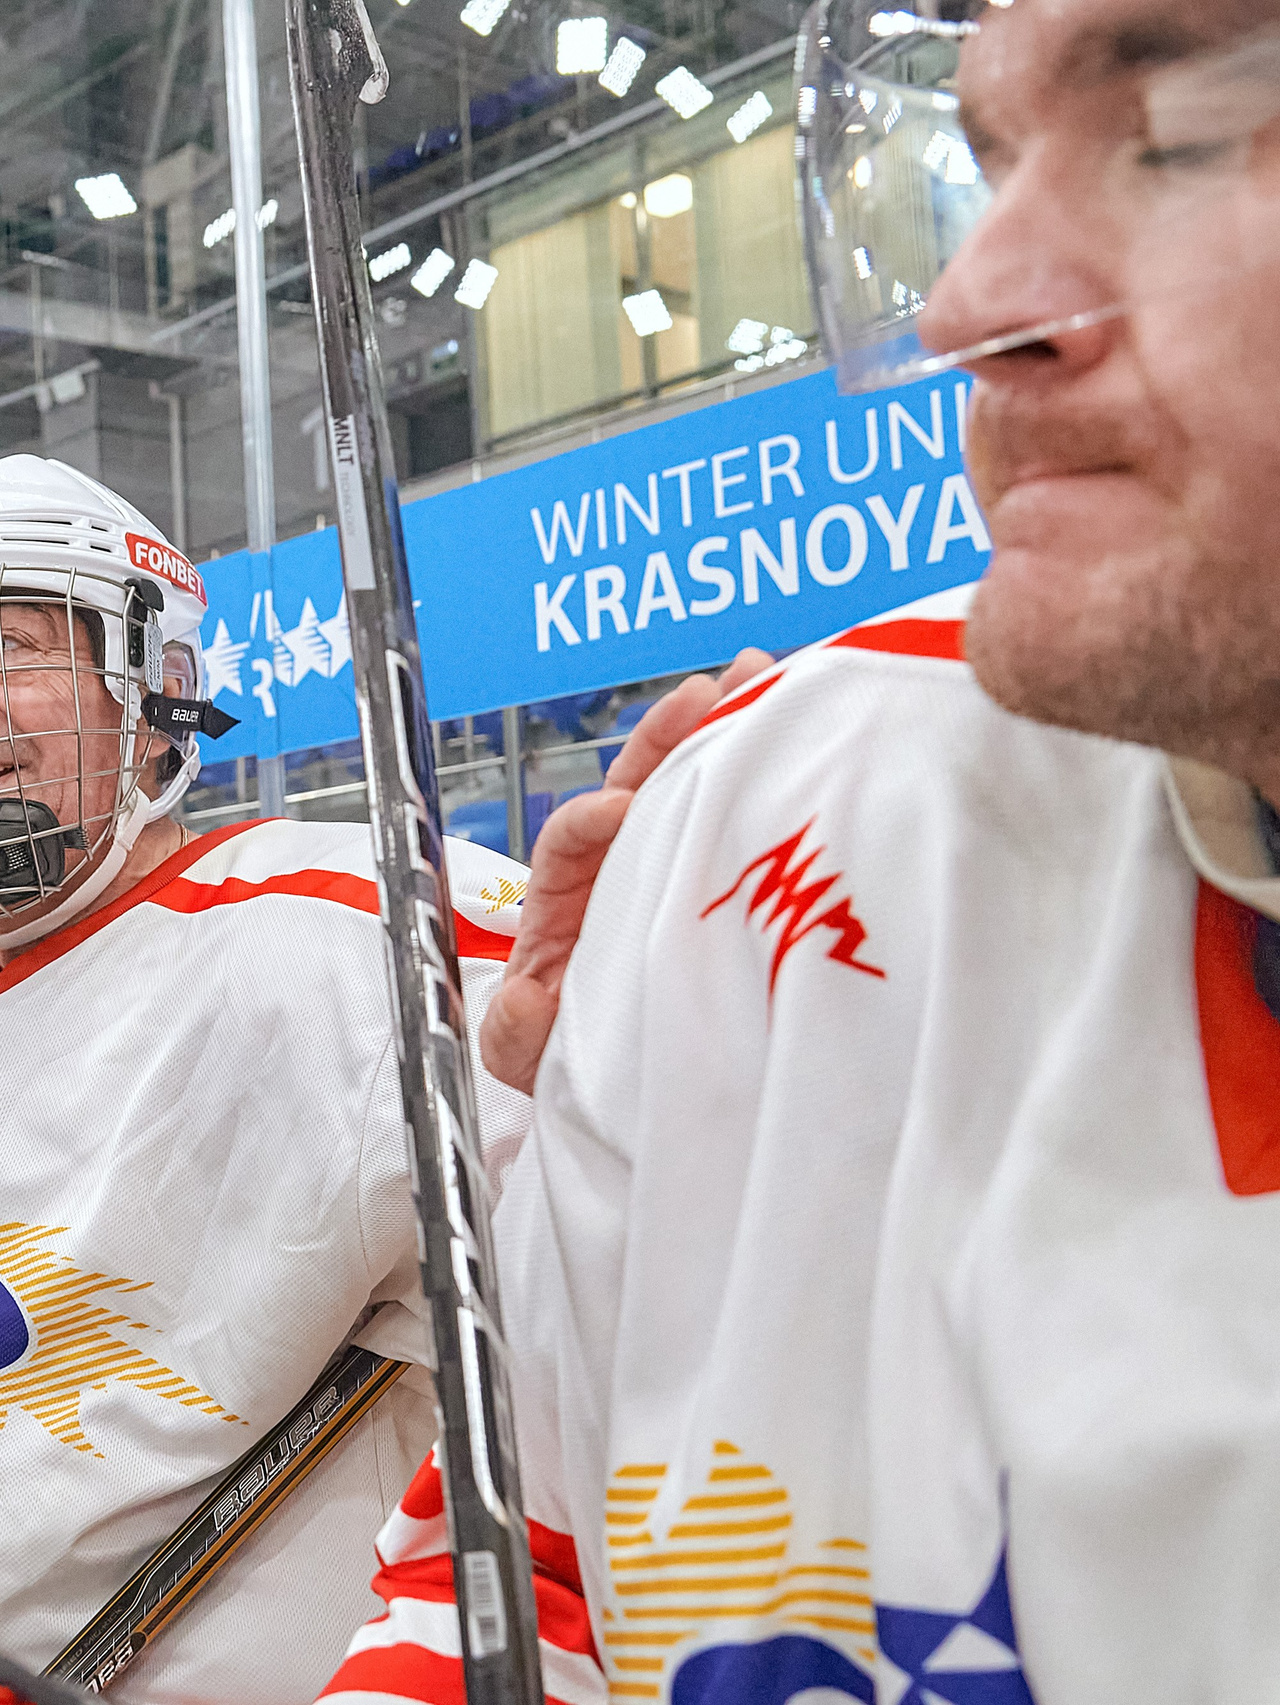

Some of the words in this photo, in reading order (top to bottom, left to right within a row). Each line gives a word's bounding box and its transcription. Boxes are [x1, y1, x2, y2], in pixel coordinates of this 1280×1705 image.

[530, 434, 805, 565] WINTER
[533, 472, 993, 653] KRASNOYA
[134, 541, 203, 598] FONBET
